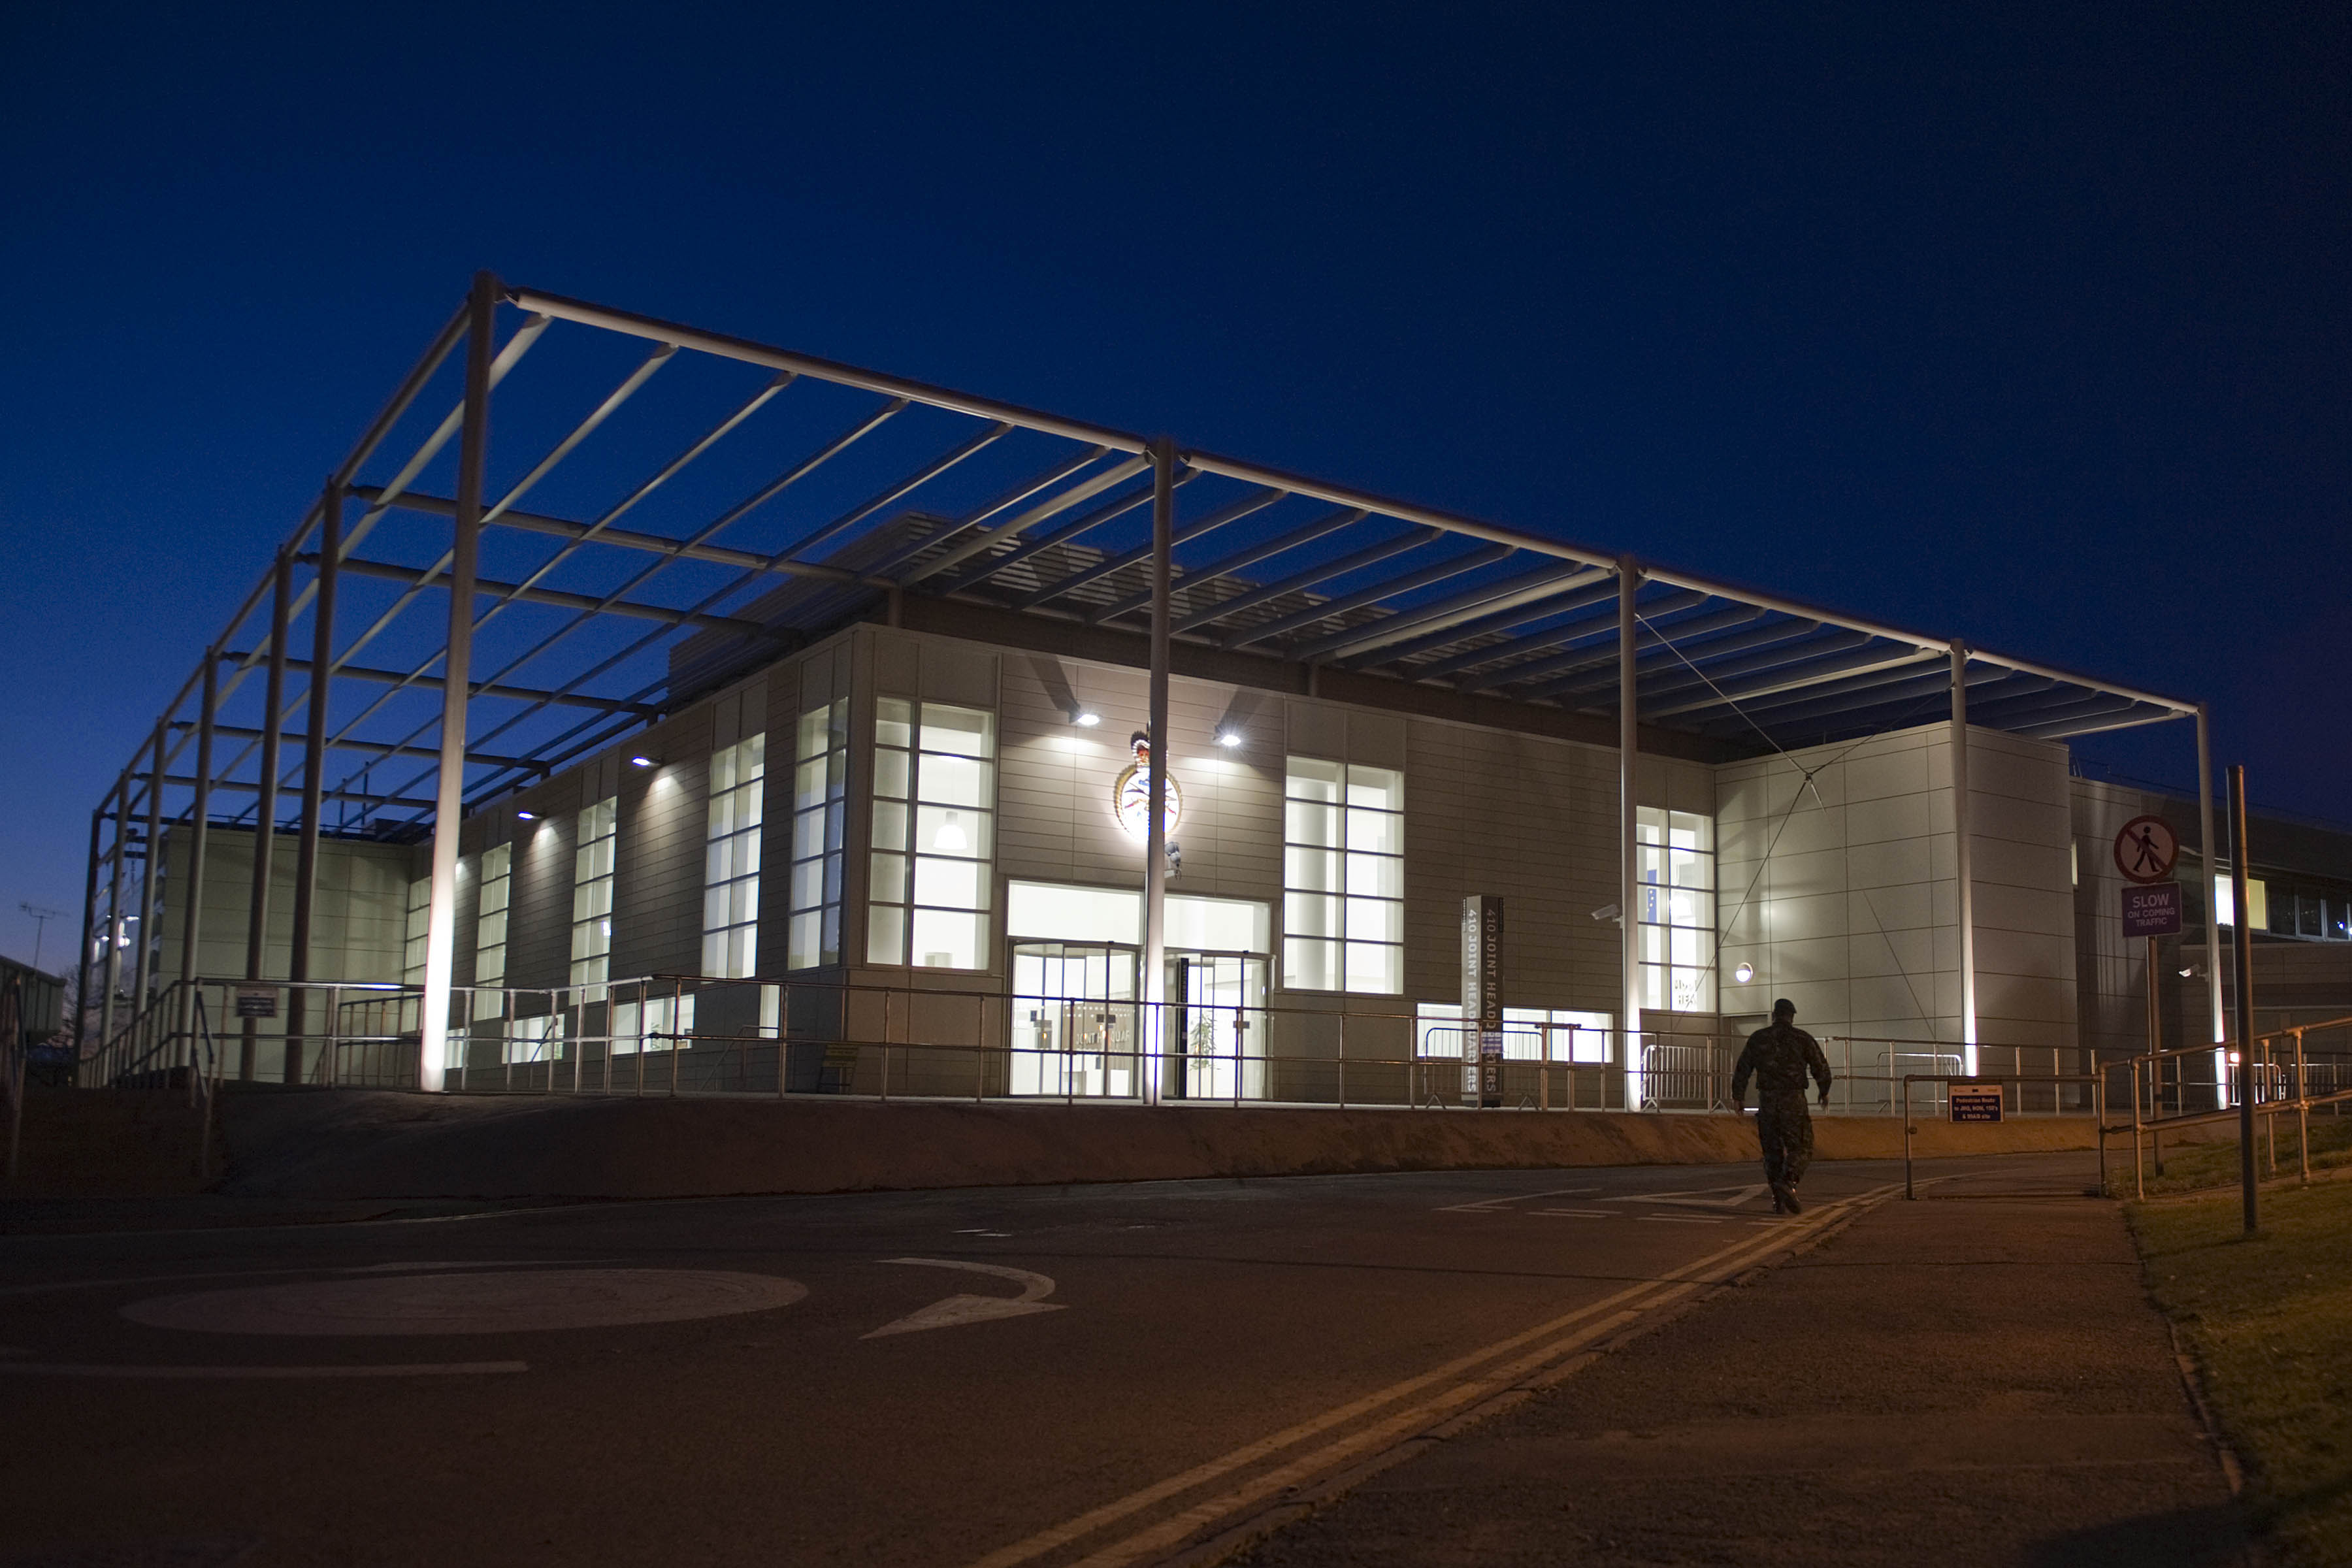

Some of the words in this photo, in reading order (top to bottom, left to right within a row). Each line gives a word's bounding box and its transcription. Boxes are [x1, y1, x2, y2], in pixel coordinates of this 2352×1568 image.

[2132, 893, 2169, 908] SLOW
[1468, 909, 1477, 932] 410
[1486, 909, 1496, 932] 410
[2127, 910, 2140, 919] ON
[2142, 907, 2175, 917] COMING
[2136, 917, 2168, 926] TRAFFIC
[1468, 935, 1477, 977] JOINT
[1486, 936, 1497, 977] JOINT
